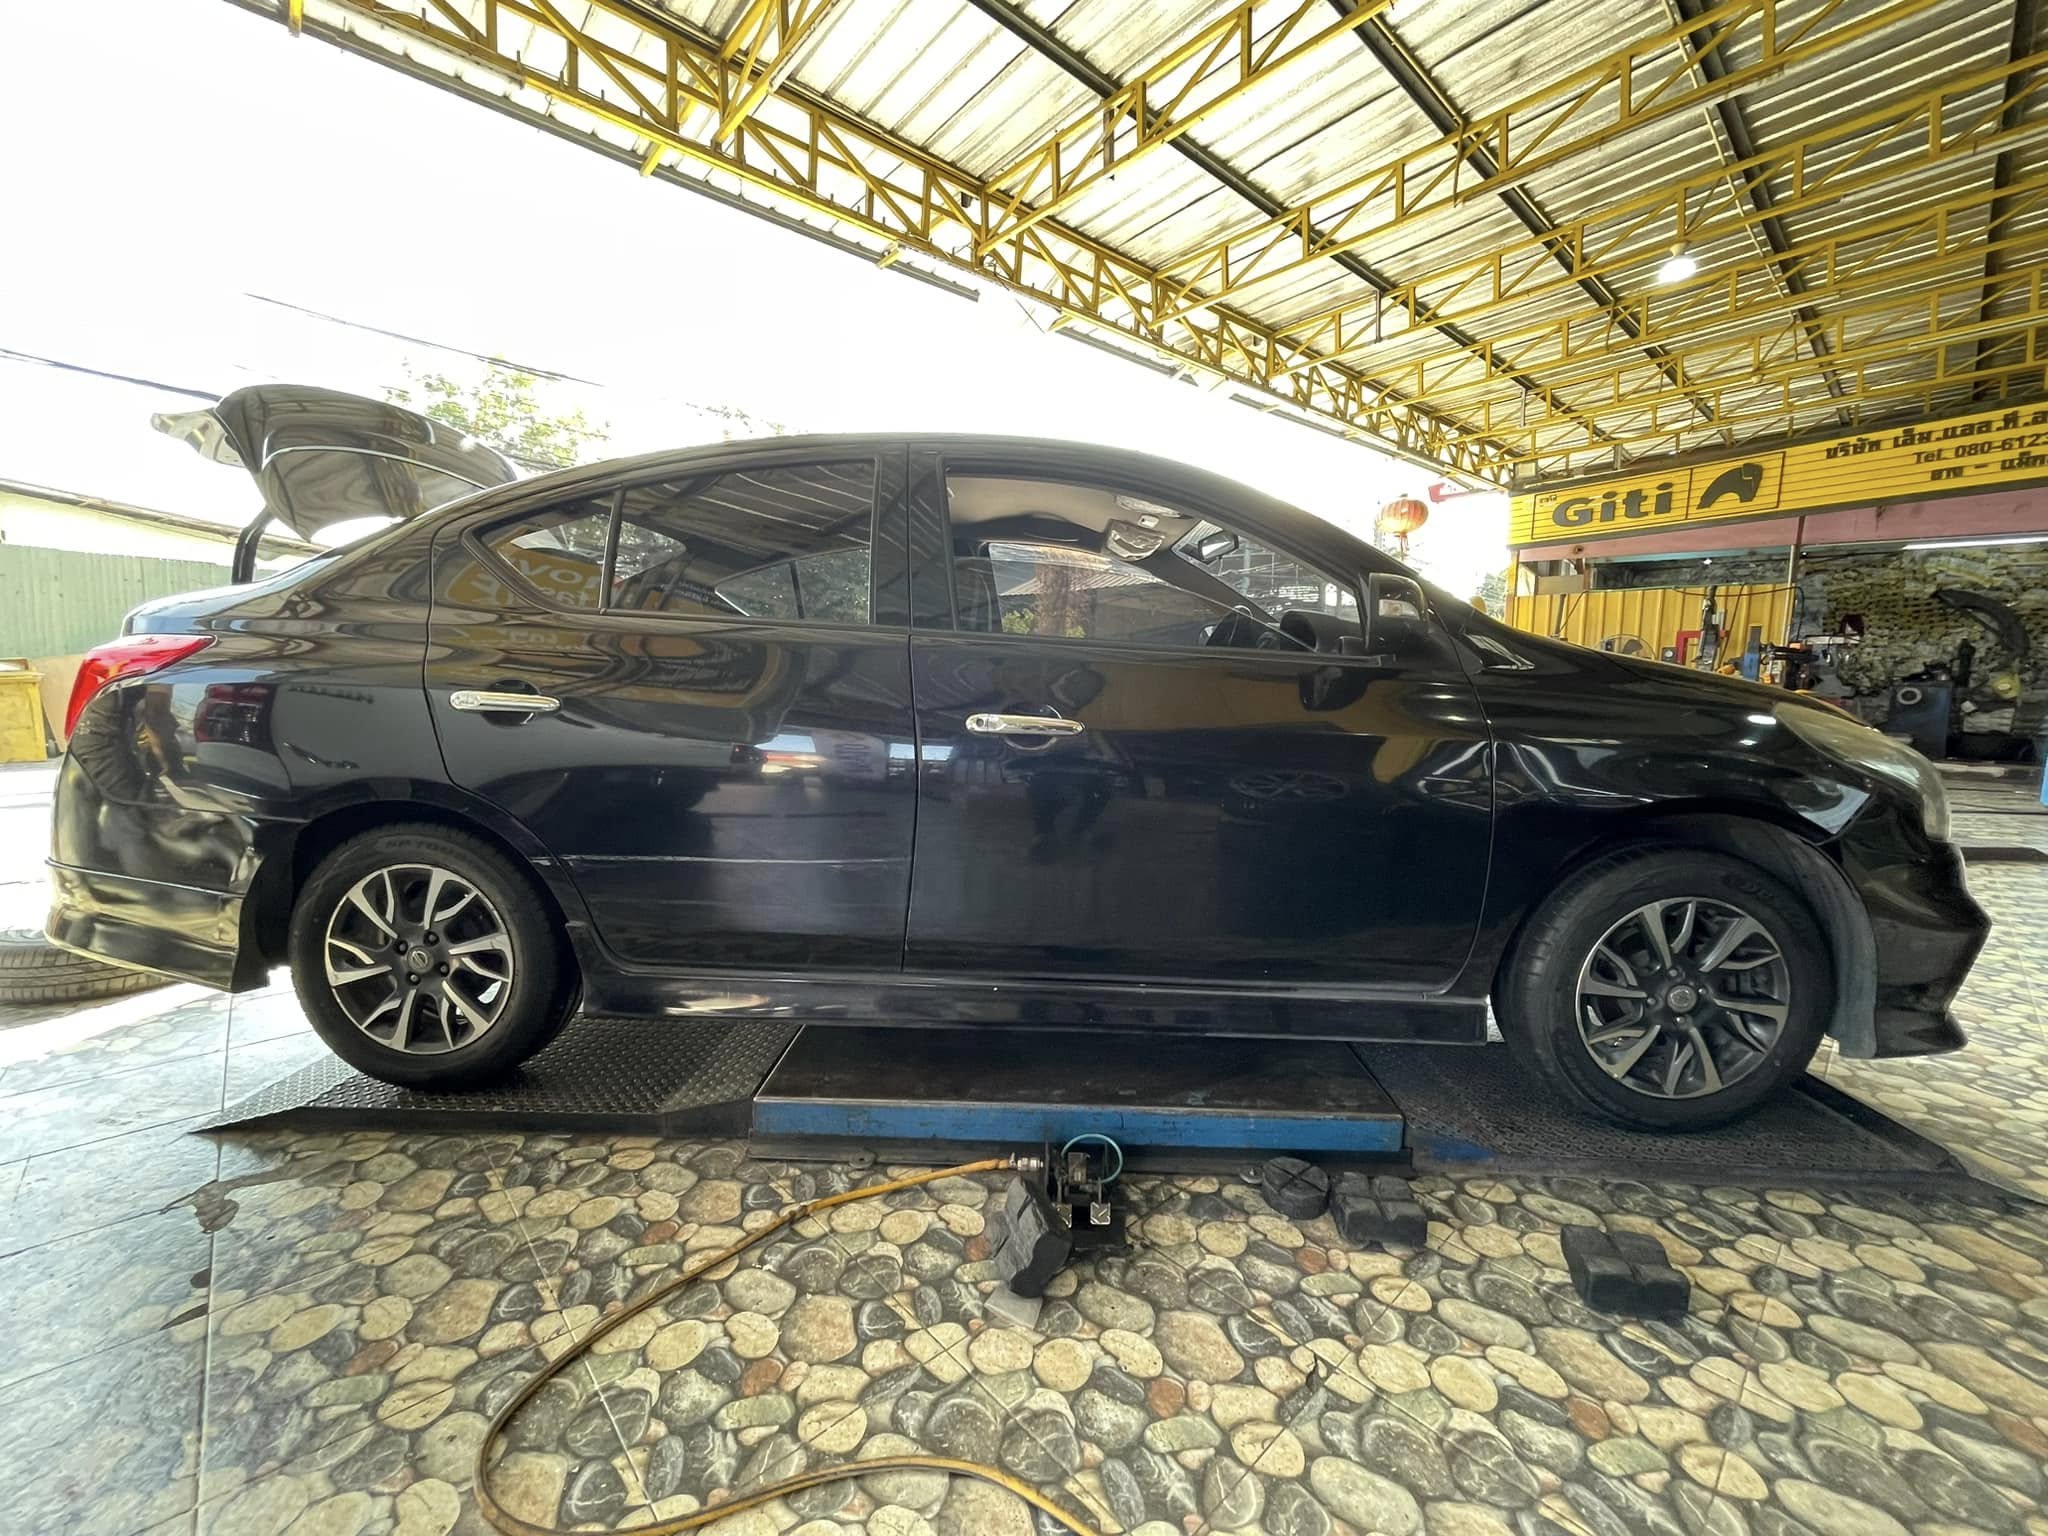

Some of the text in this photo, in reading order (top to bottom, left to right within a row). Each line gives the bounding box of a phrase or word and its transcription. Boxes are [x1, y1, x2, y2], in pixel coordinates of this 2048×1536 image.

[1825, 437, 1881, 460] บริษัท
[1552, 482, 1674, 528] Giti
